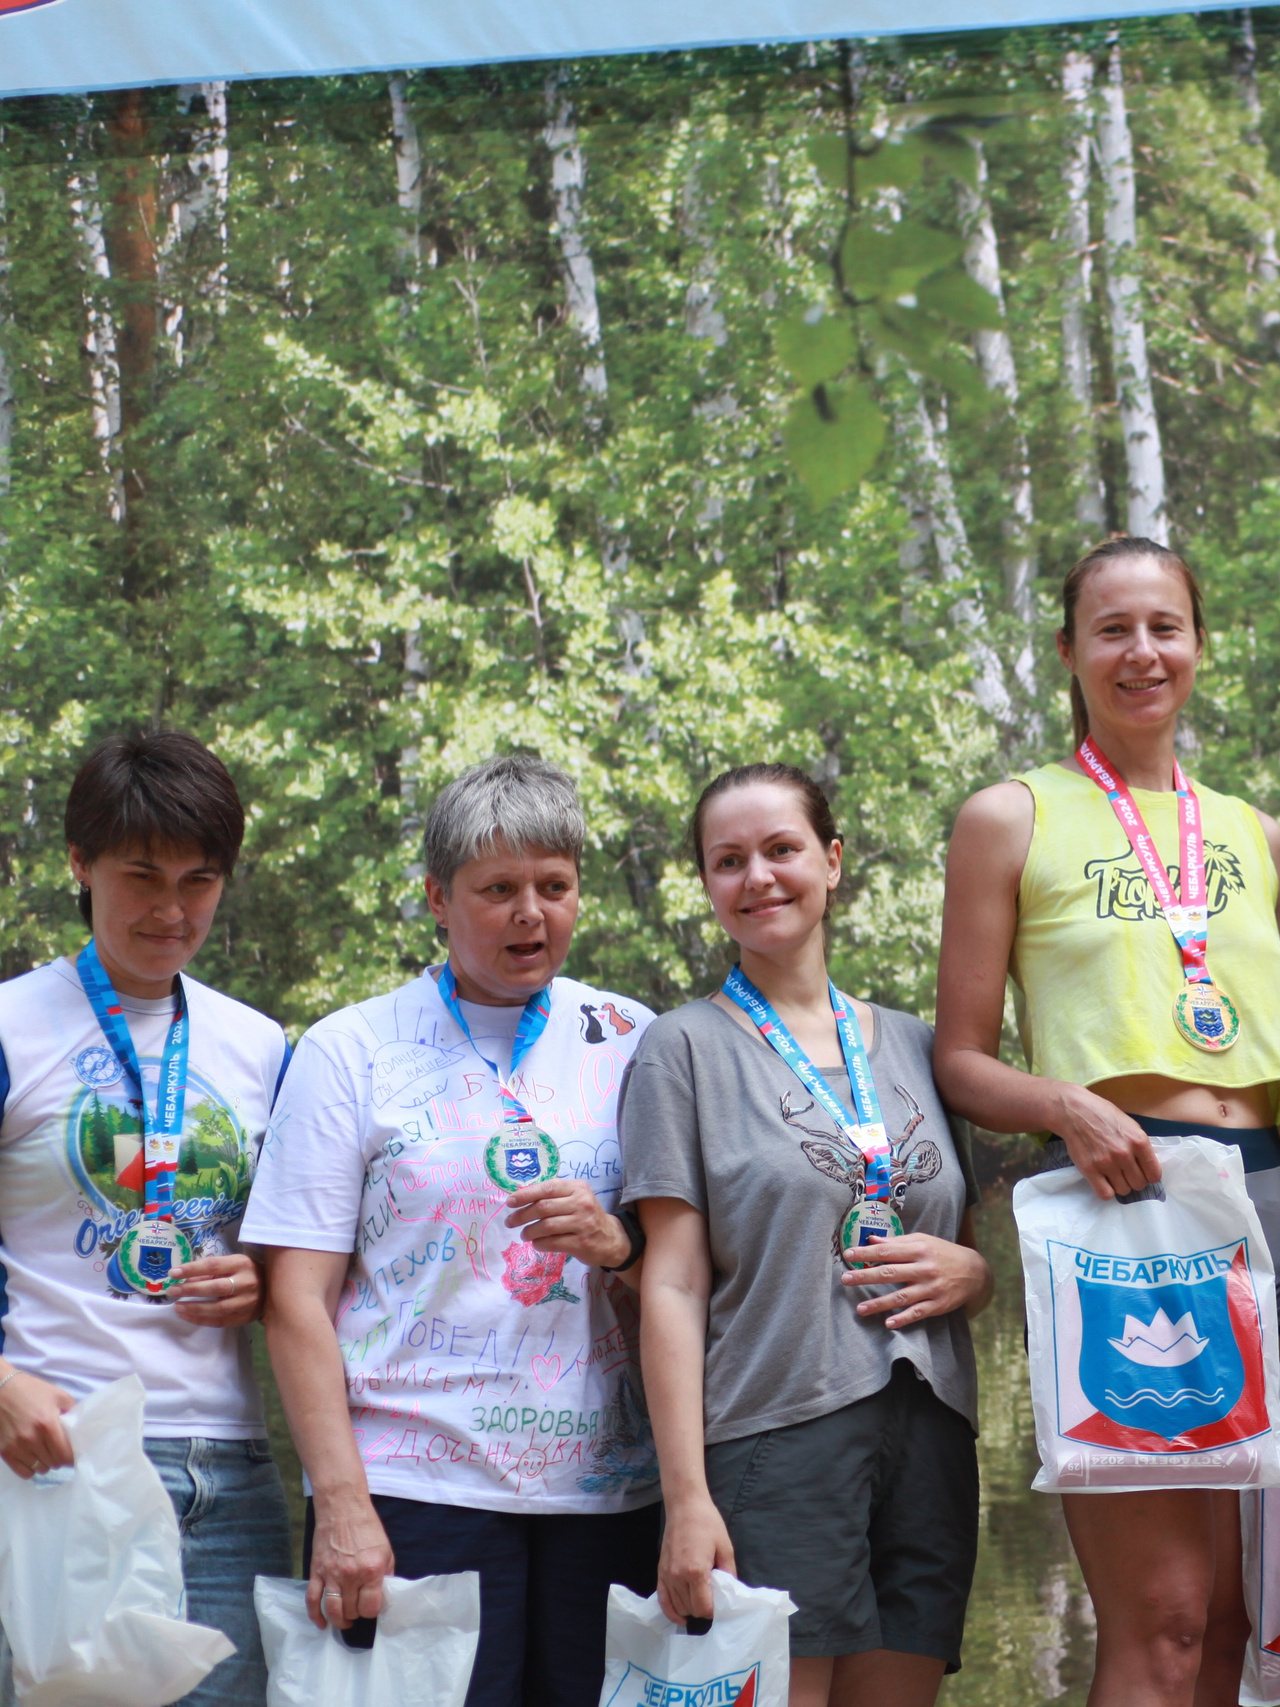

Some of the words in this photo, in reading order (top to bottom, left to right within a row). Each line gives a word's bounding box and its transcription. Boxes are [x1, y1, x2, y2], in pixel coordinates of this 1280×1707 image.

[1117, 799, 1138, 826] 2024
[1185, 799, 1195, 826] 2024
[1136, 834, 1171, 904] ЧЕБАРКУЛЬ
[1187, 832, 1197, 899] ЧЕБАРКУЛЬ
[771, 1028, 795, 1054] 2024
[847, 1022, 858, 1047] 2024
[375, 1047, 426, 1079] СОЛНЦЕ
[164, 1053, 180, 1127] ЧЕБАРКУЛЬ
[798, 1060, 845, 1121] ЧЕБАРКУЛЬ
[852, 1055, 872, 1118] ЧЕБАРКУЛЬ
[1075, 1251, 1232, 1285] ЧЕБАРКУЛЬ
[469, 1405, 600, 1438] ЗДОРОВЬЯ
[1067, 1462, 1081, 1472] 29
[1091, 1456, 1126, 1466] 2024
